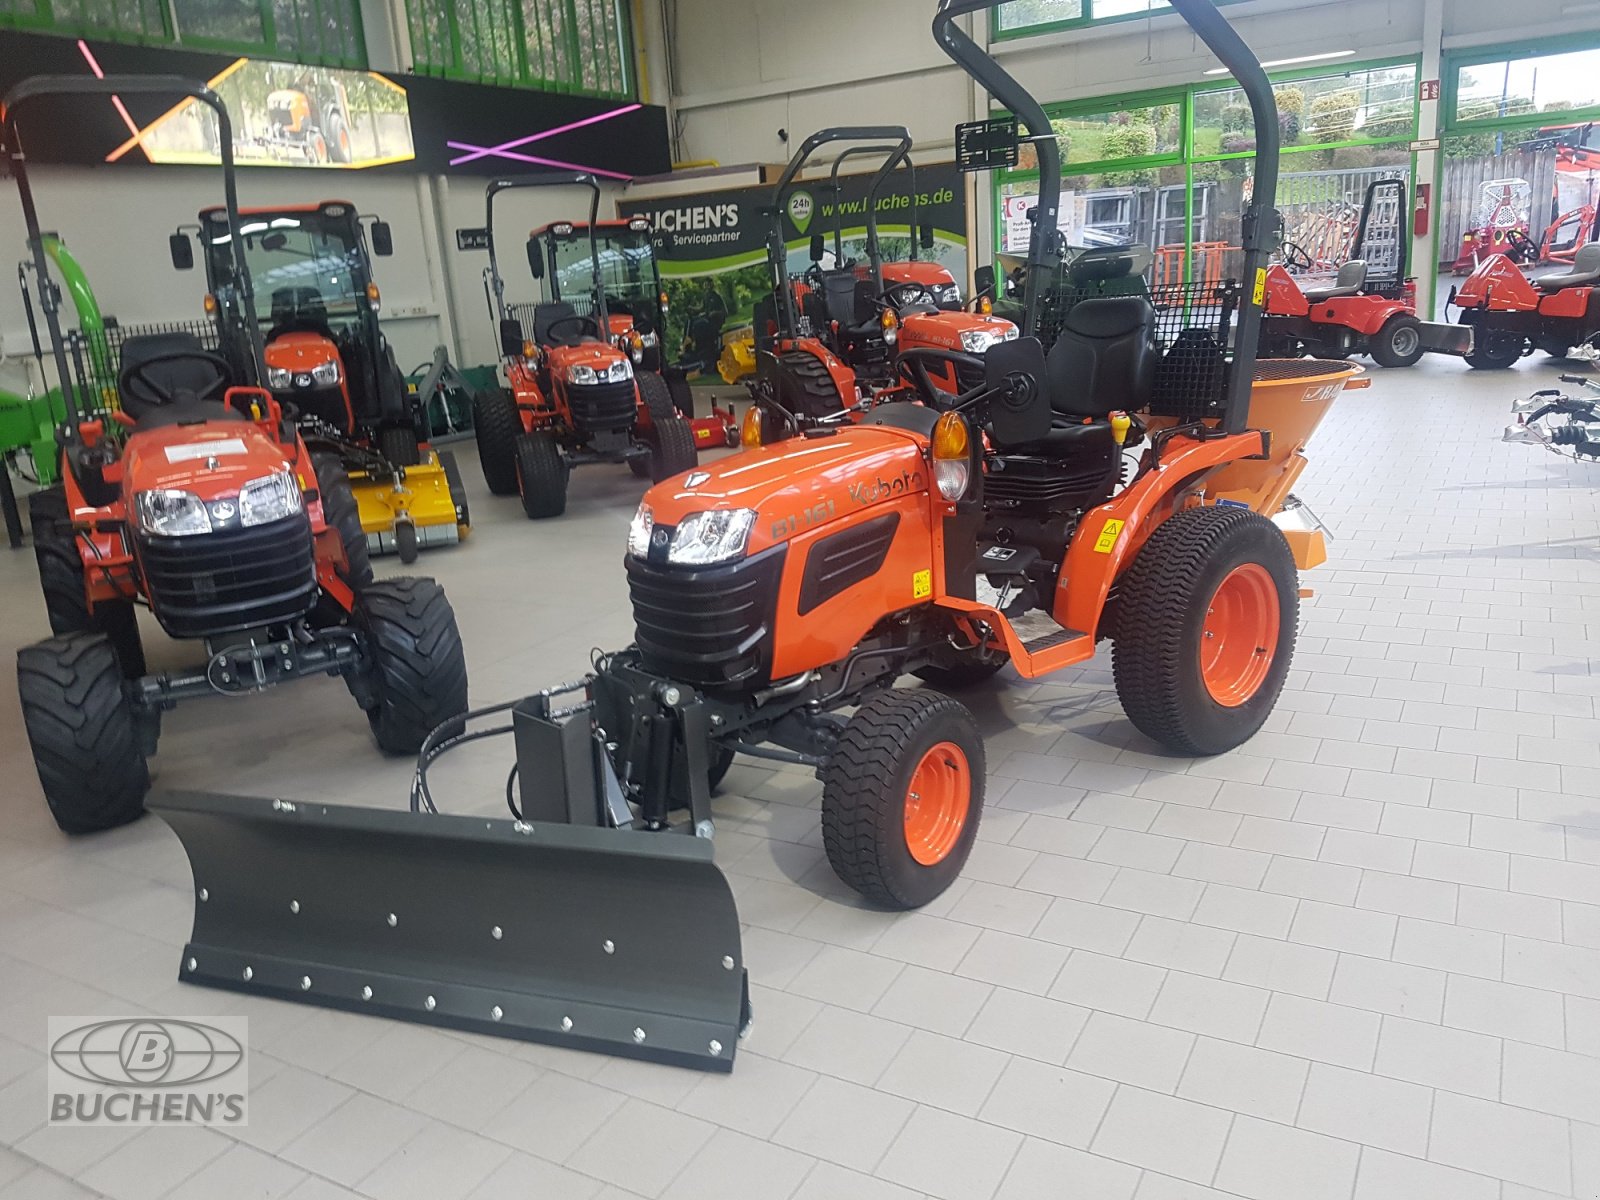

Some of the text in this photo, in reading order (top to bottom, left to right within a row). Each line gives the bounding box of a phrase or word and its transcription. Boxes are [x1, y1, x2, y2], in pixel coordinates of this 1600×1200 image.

[793, 198, 810, 209] 24h
[673, 231, 741, 246] Servicepartner
[848, 470, 922, 504] Kubota
